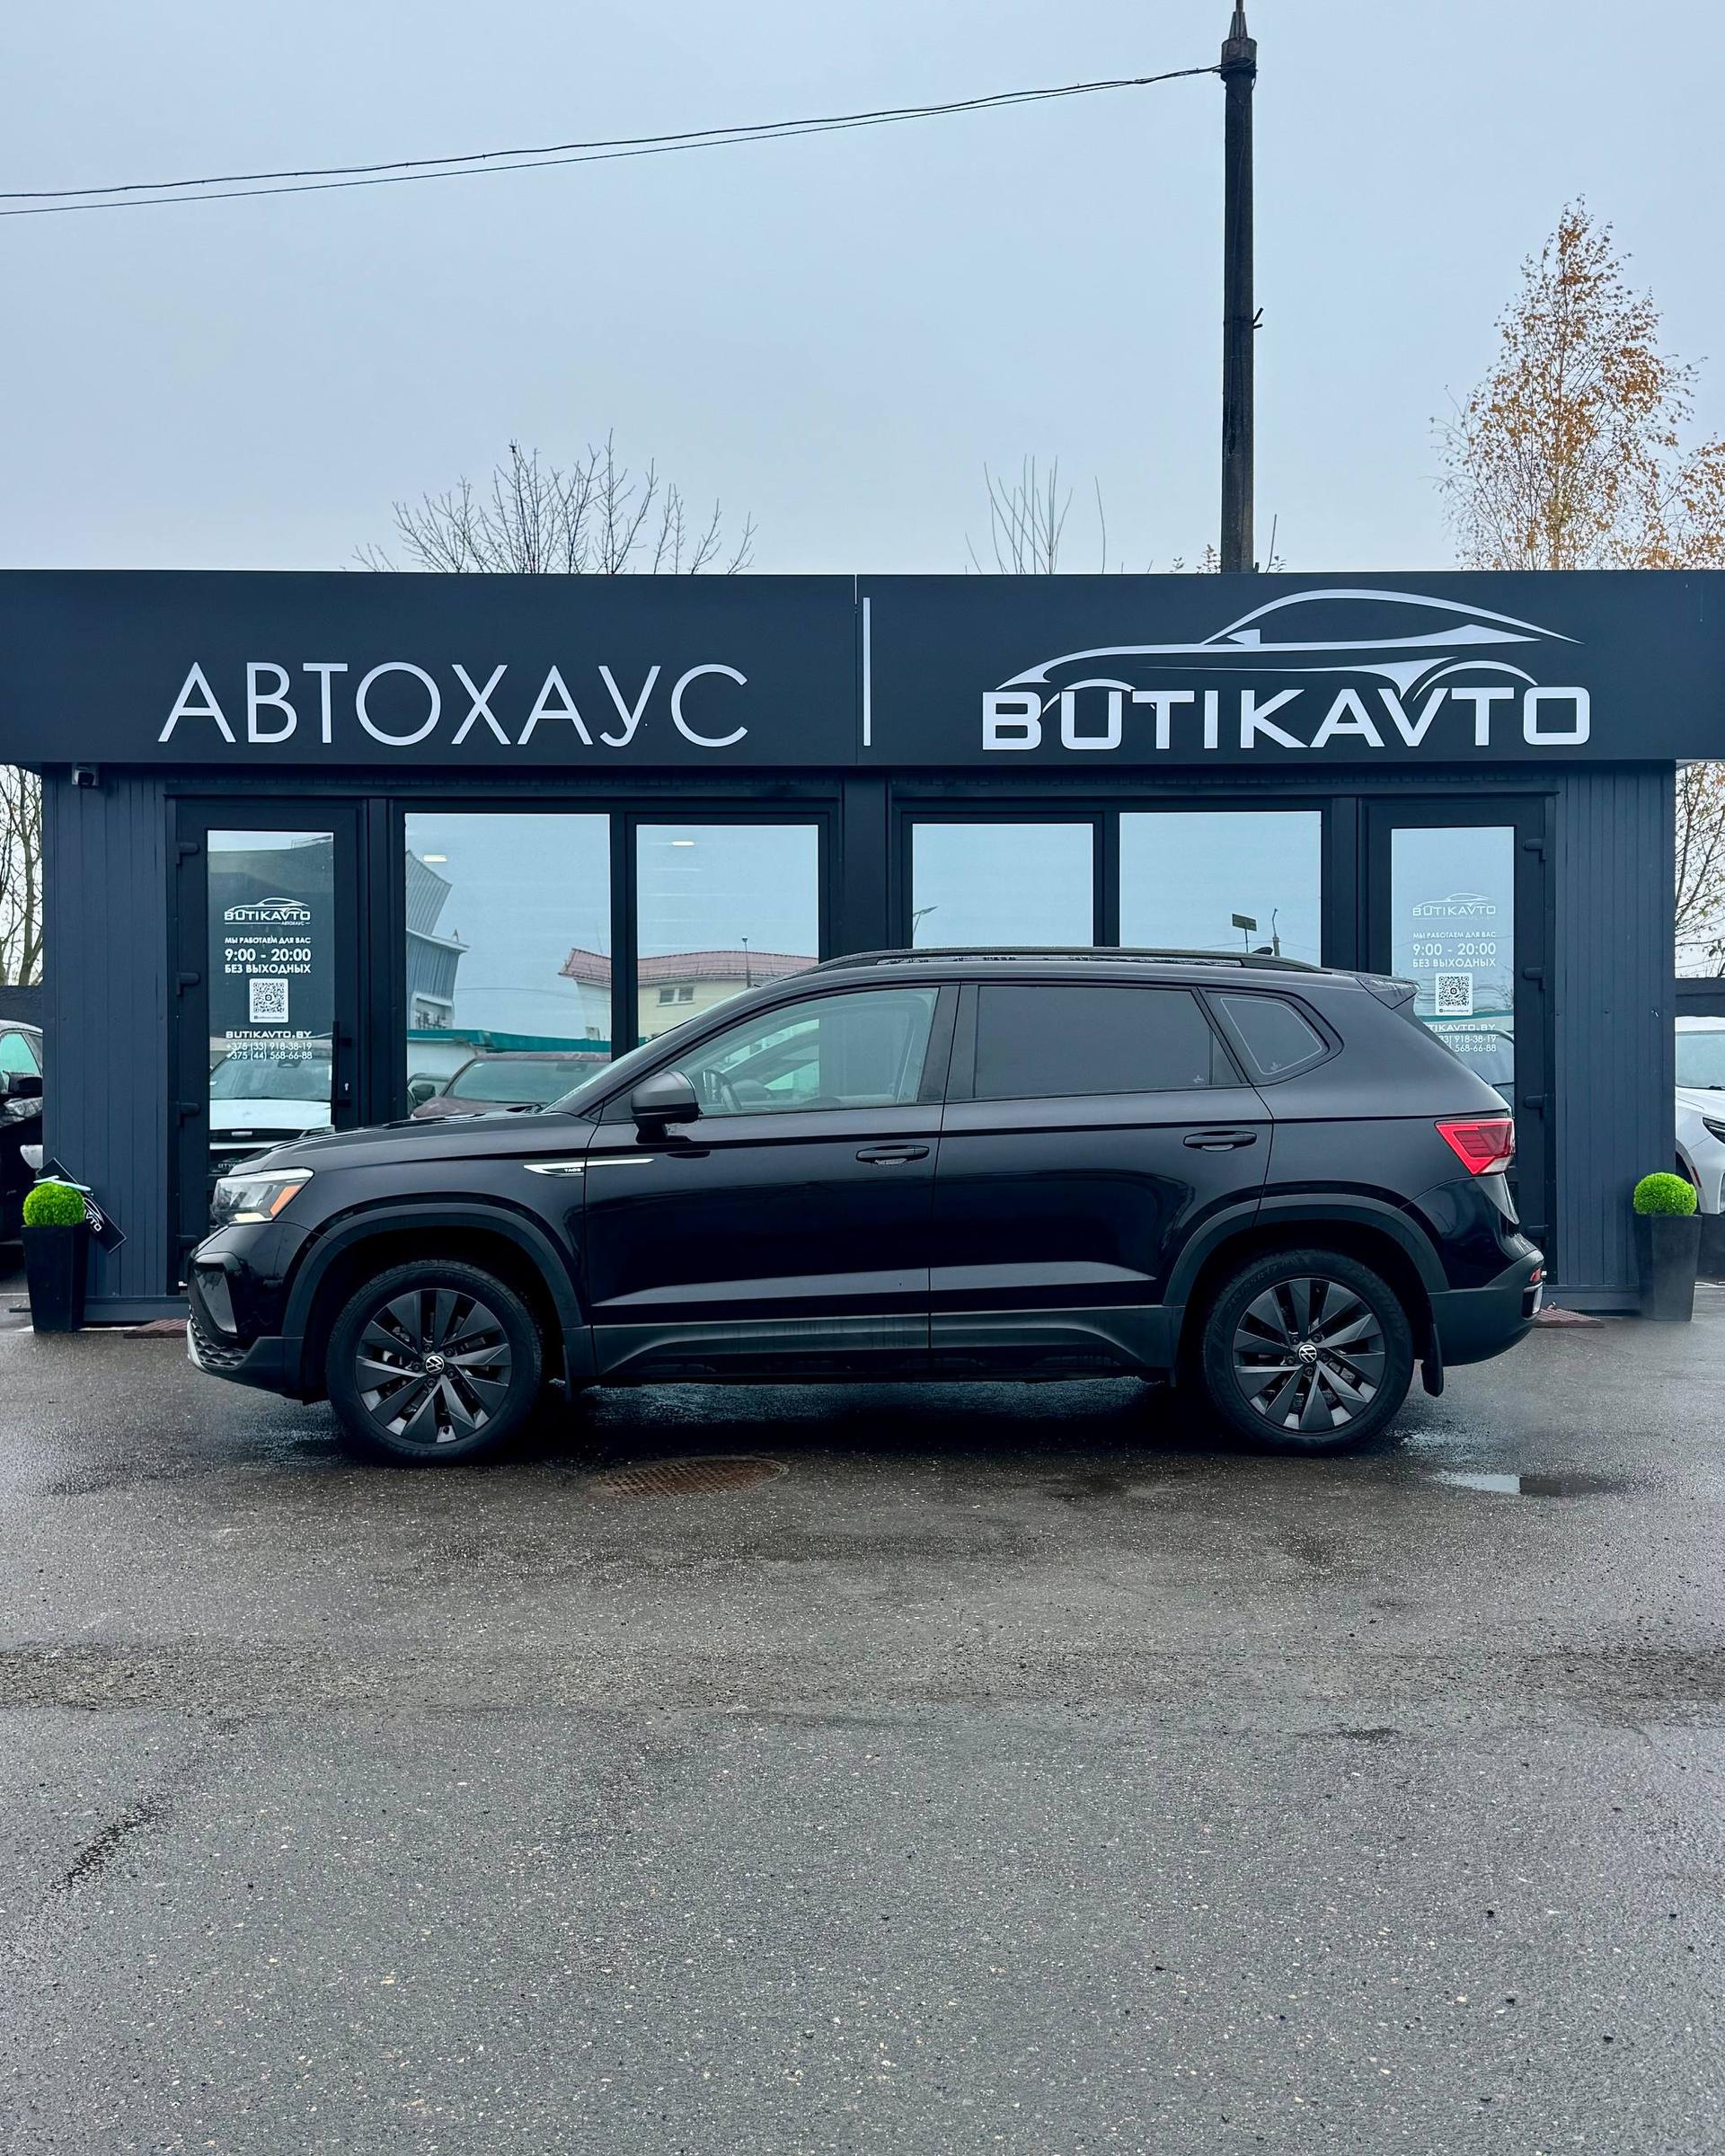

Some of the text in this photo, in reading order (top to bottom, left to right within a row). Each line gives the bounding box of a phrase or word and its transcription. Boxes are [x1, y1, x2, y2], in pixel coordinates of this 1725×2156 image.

[158, 662, 748, 747] АВТОХАУС
[982, 685, 1590, 750] BUTIKAVTO
[224, 910, 311, 921] BUTIKAVTO
[1412, 906, 1496, 916] BUTIKAVTO
[279, 937, 294, 945] ДЛЯ
[1412, 943, 1443, 956] 9:00
[1457, 942, 1496, 956] 20:00
[225, 948, 256, 962] 9:00
[270, 948, 312, 962] 20:00
[1412, 958, 1496, 968] БЕЗ ВЫХОДНЫХ
[225, 963, 312, 975] БЕЗ ВЫХОДНЫХ
[1426, 1024, 1496, 1032] TIKAVTO.BY
[226, 1030, 313, 1039] BUTIKAVTO.BY
[1455, 1035, 1497, 1043] 918-38-19
[226, 1042, 313, 1052] +375 (33) 918-38-19
[1455, 1044, 1497, 1053] 568-66-88
[251, 1051, 267, 1061] (44)
[270, 1051, 314, 1060] 568-66-88
